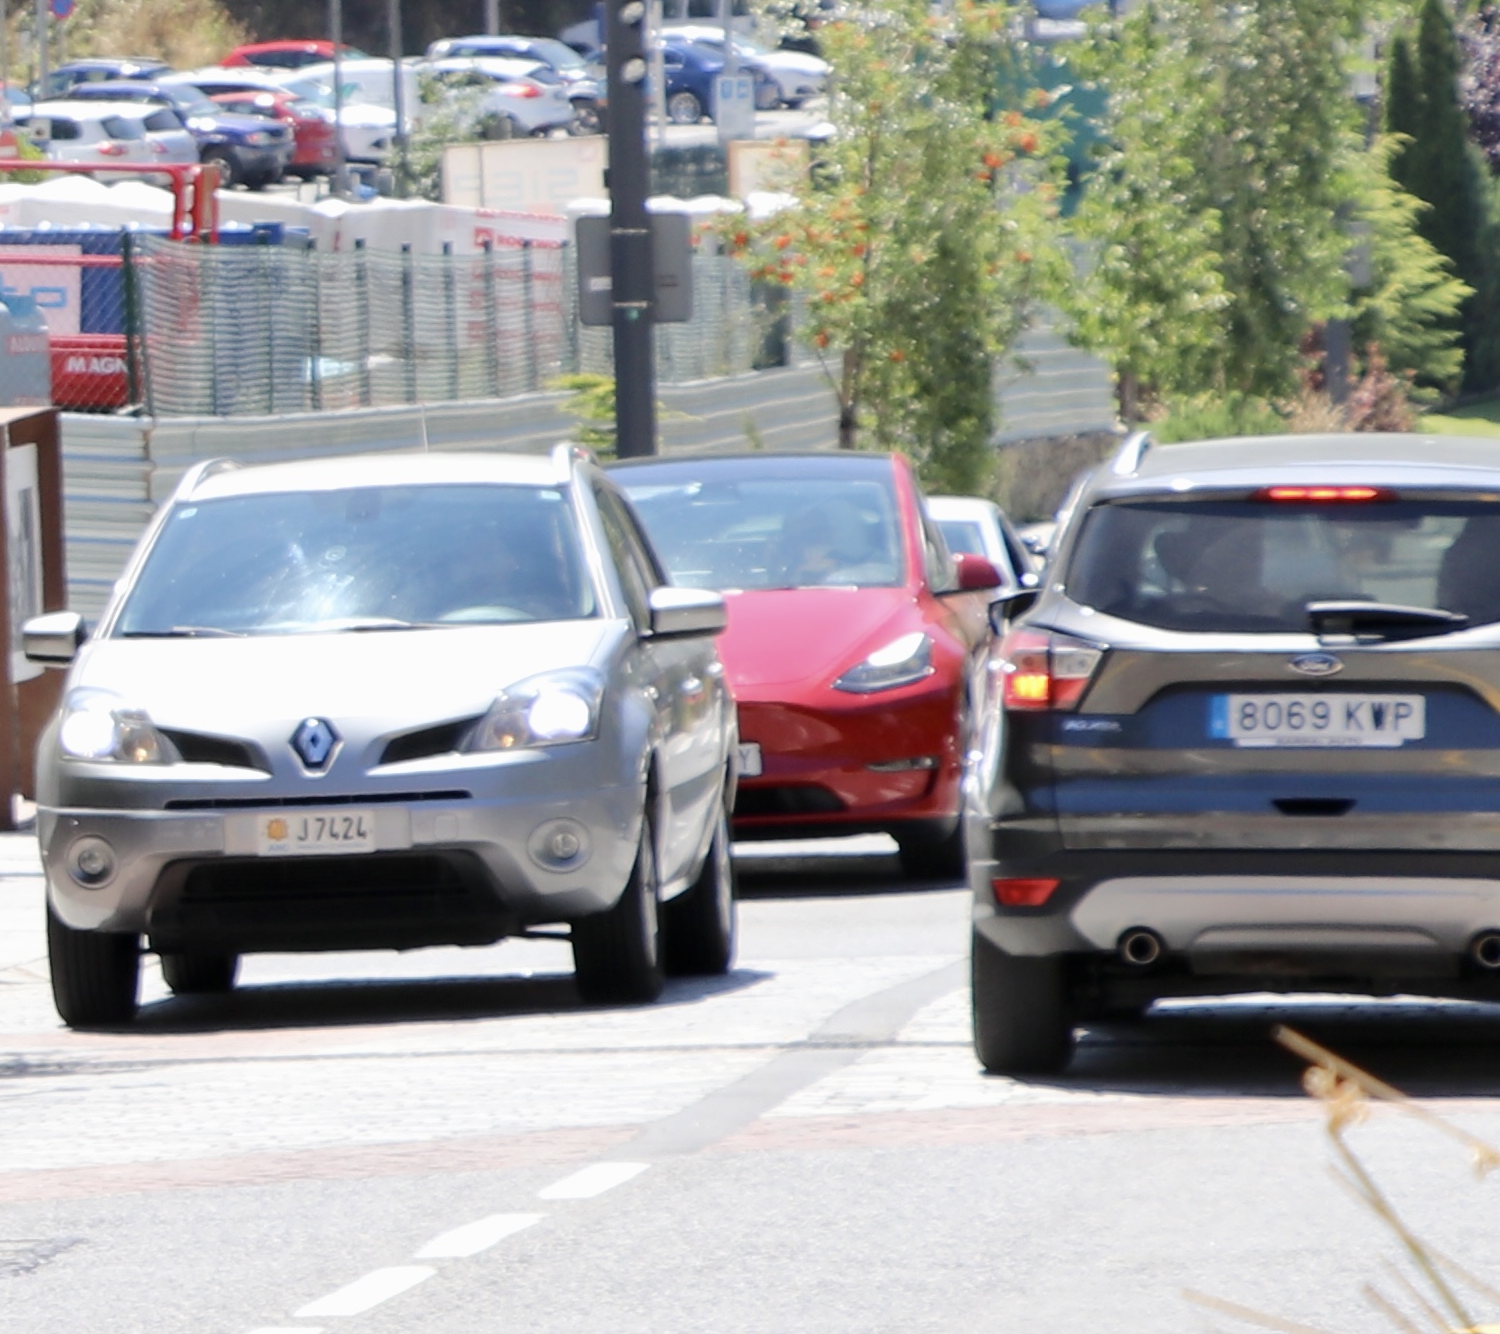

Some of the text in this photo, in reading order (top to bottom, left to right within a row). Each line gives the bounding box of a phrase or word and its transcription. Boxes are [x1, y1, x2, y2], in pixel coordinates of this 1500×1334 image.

[66, 355, 130, 374] MAGN
[1240, 700, 1414, 732] 8069 KWP
